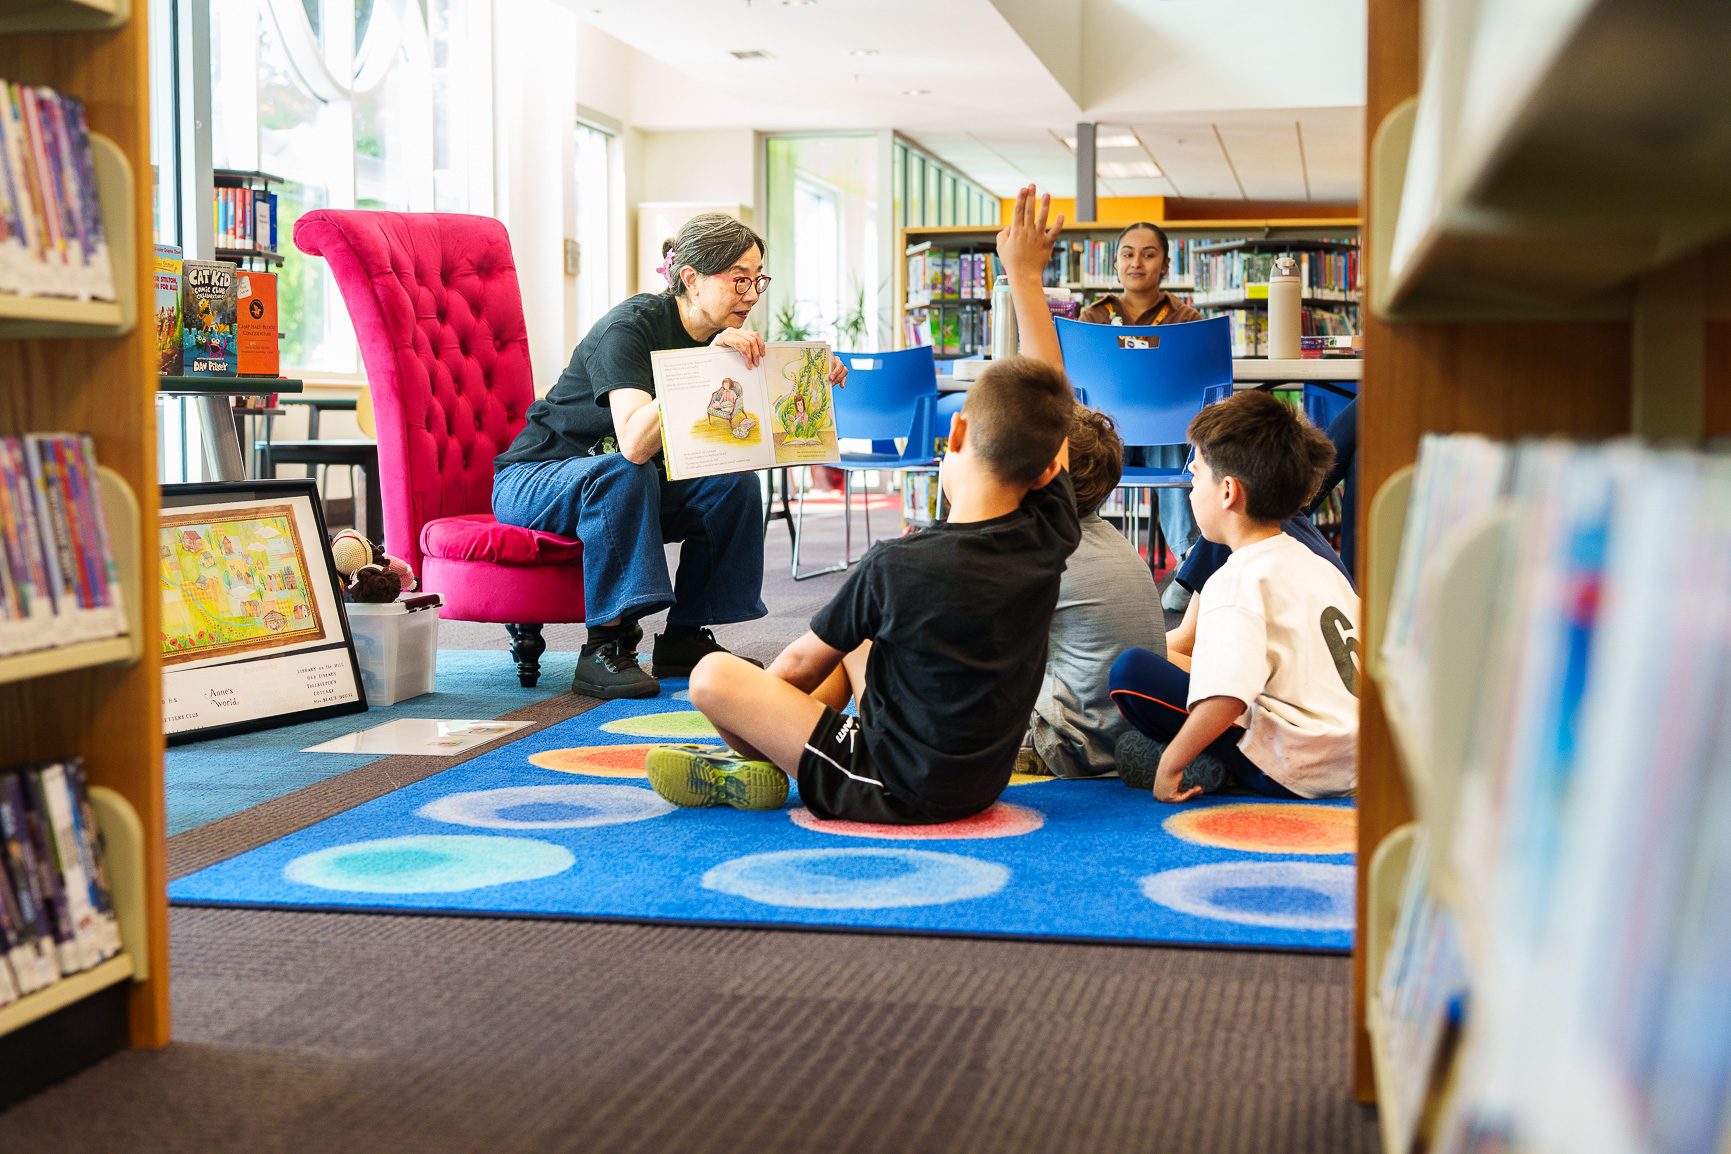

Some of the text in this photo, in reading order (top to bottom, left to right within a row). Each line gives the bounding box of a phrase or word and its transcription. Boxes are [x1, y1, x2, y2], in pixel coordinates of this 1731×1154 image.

[188, 268, 211, 286] CAT
[211, 286, 226, 295] CLUB
[193, 360, 208, 372] DAV
[1320, 606, 1361, 697] 6
[204, 688, 234, 700] Anne's
